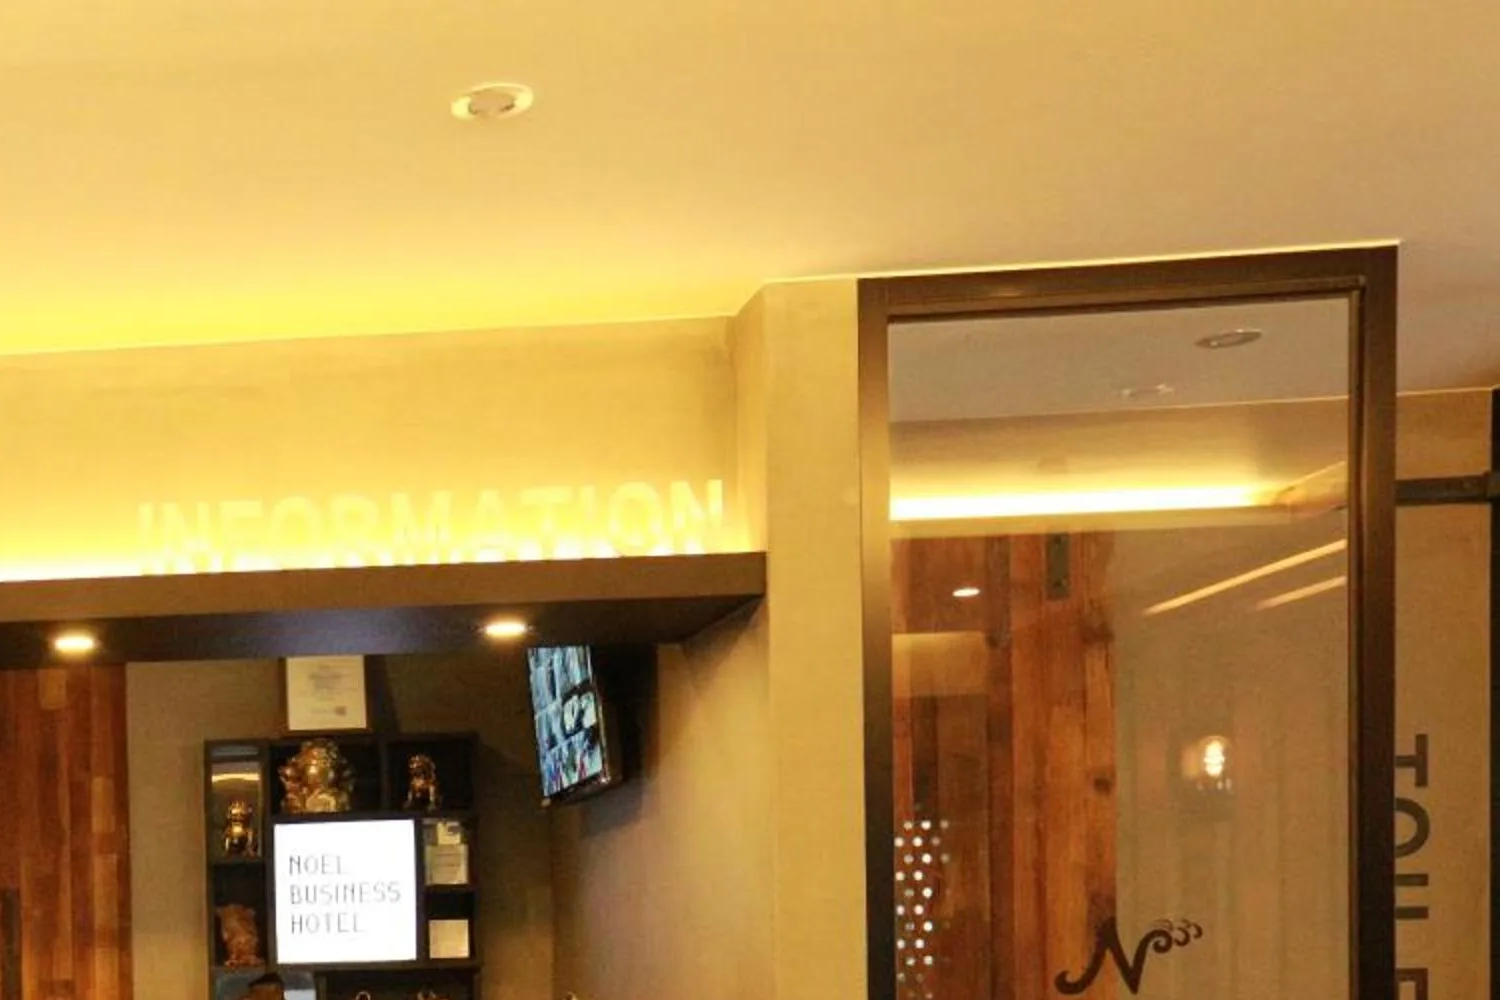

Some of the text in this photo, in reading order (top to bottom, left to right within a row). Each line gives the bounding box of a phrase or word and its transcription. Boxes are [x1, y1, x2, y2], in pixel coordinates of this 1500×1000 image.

[137, 478, 724, 575] INFORMATION
[288, 854, 348, 876] NOEL
[290, 880, 402, 905] BUSINESS
[291, 912, 366, 935] HOTEL
